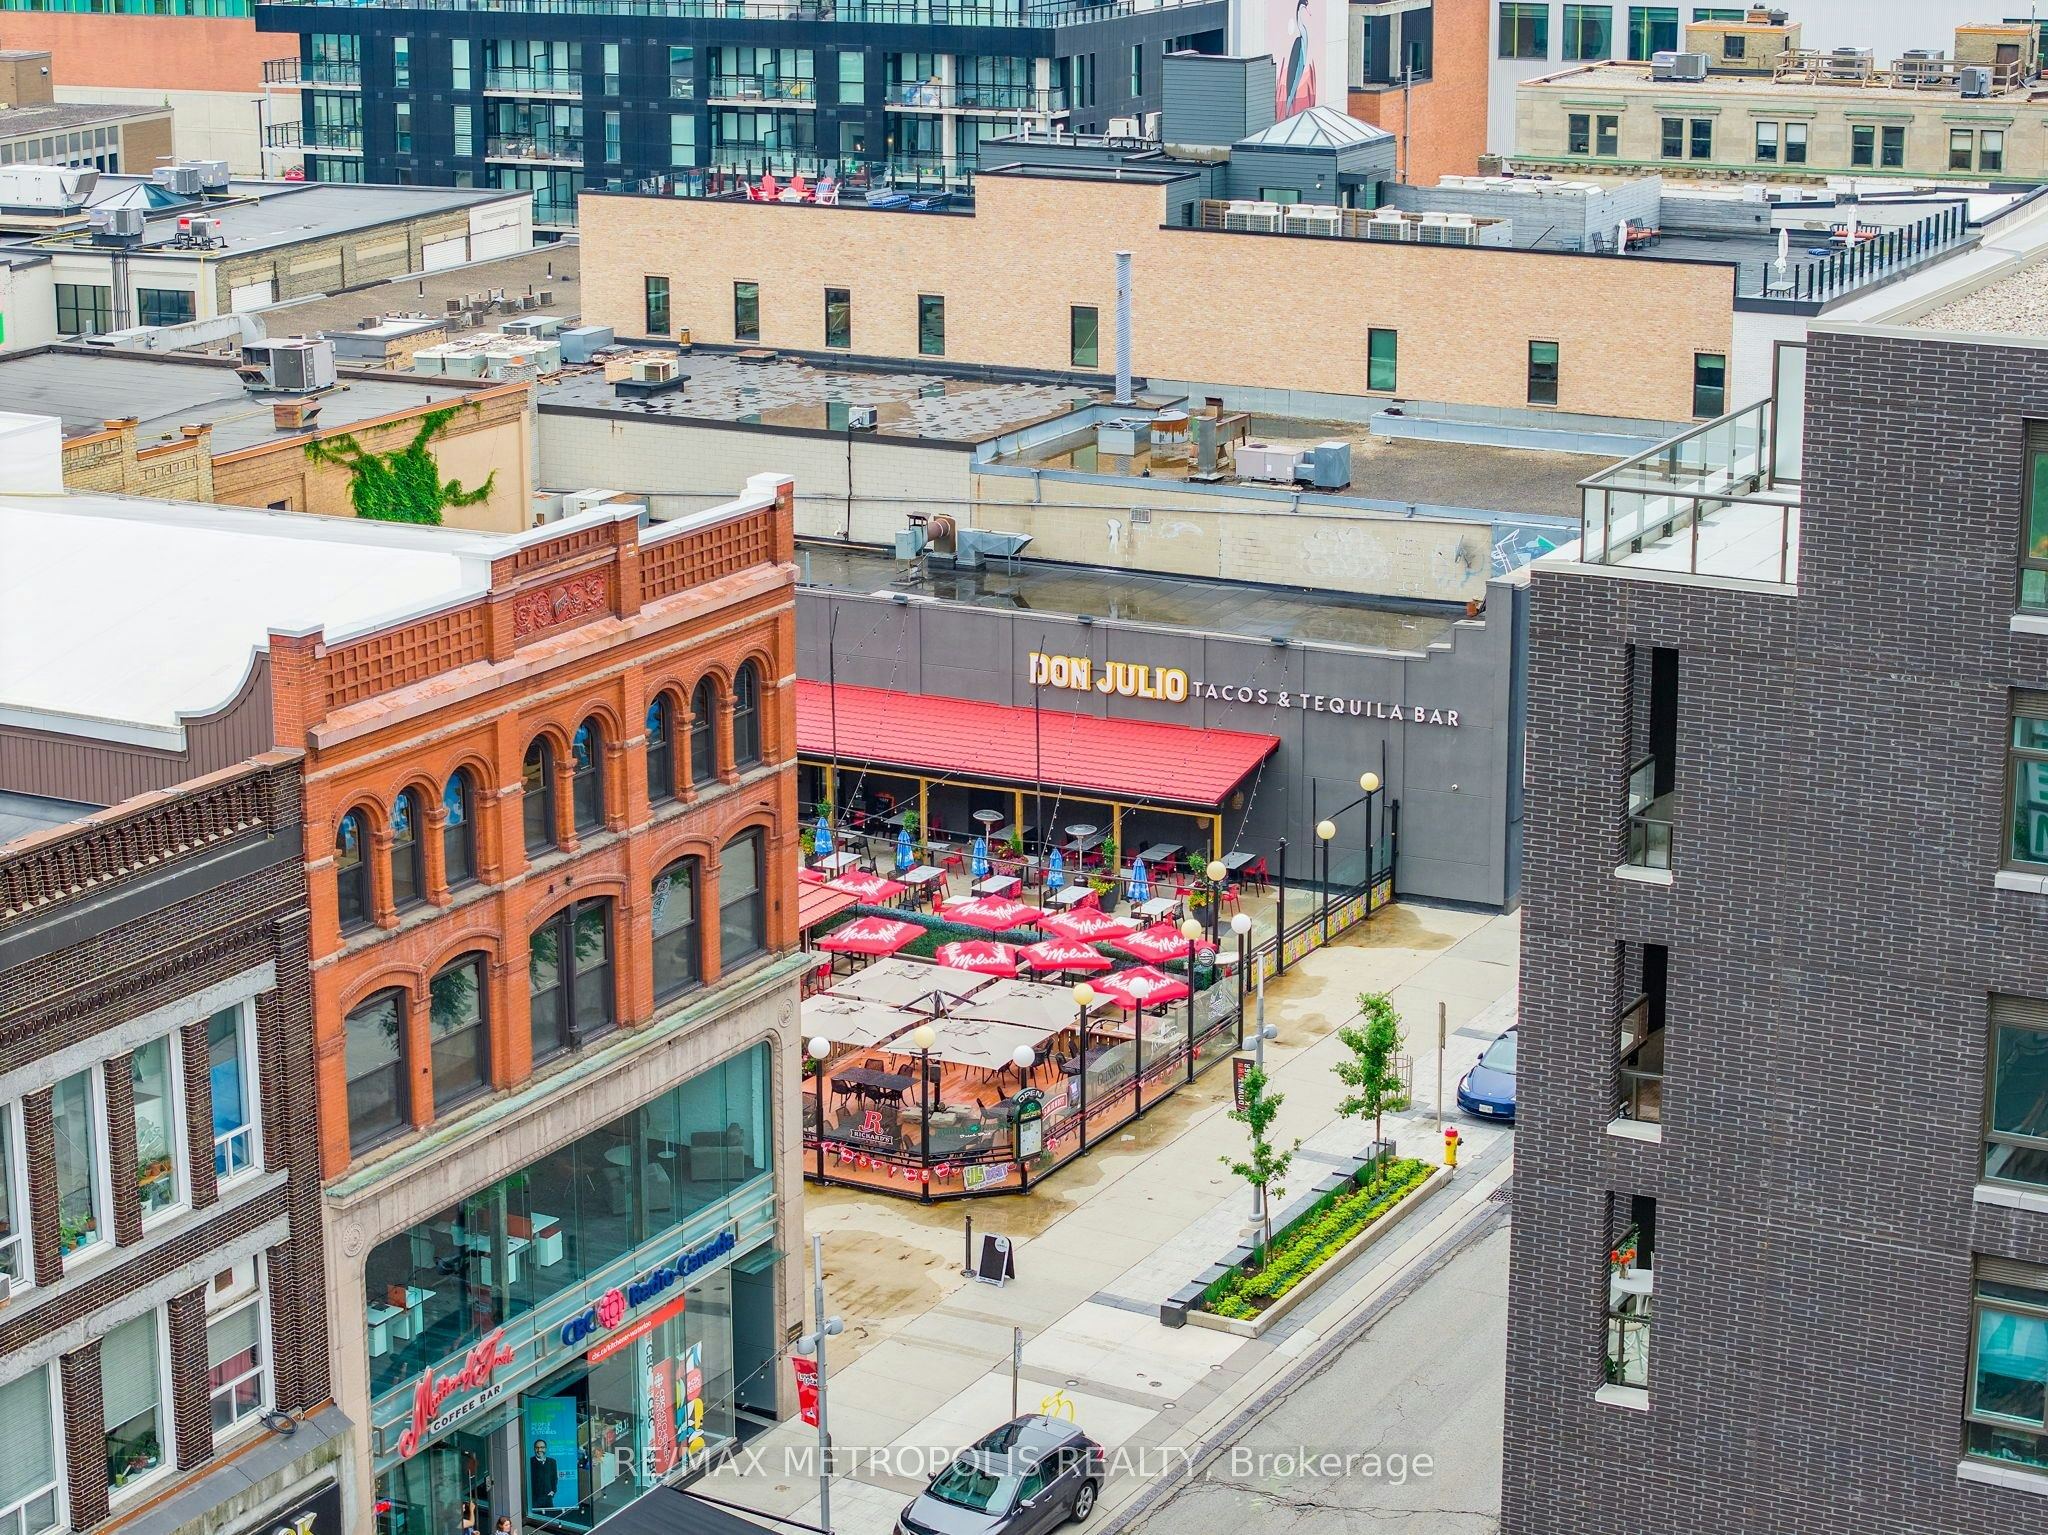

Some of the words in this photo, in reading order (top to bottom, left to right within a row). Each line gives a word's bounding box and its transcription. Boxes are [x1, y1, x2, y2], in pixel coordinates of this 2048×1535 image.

[1029, 652, 1091, 691] DON
[1096, 661, 1187, 703] JULIO
[1193, 681, 1268, 705] TACOS
[1277, 691, 1291, 708] &
[1300, 693, 1403, 721] TEQUILA
[1414, 705, 1459, 727] BAR
[835, 925, 884, 943] Molson
[1078, 917, 1123, 935] Molson
[1045, 948, 1100, 963] Molson
[1018, 1090, 1042, 1103] OPEN
[859, 1110, 884, 1136] R
[561, 1307, 597, 1346] CBC
[628, 1231, 735, 1308] Radio-Canada
[591, 1321, 652, 1361] cbc.ca/kitchener-waterloo
[434, 1400, 475, 1431] COFFEE
[480, 1385, 501, 1404] BAR
